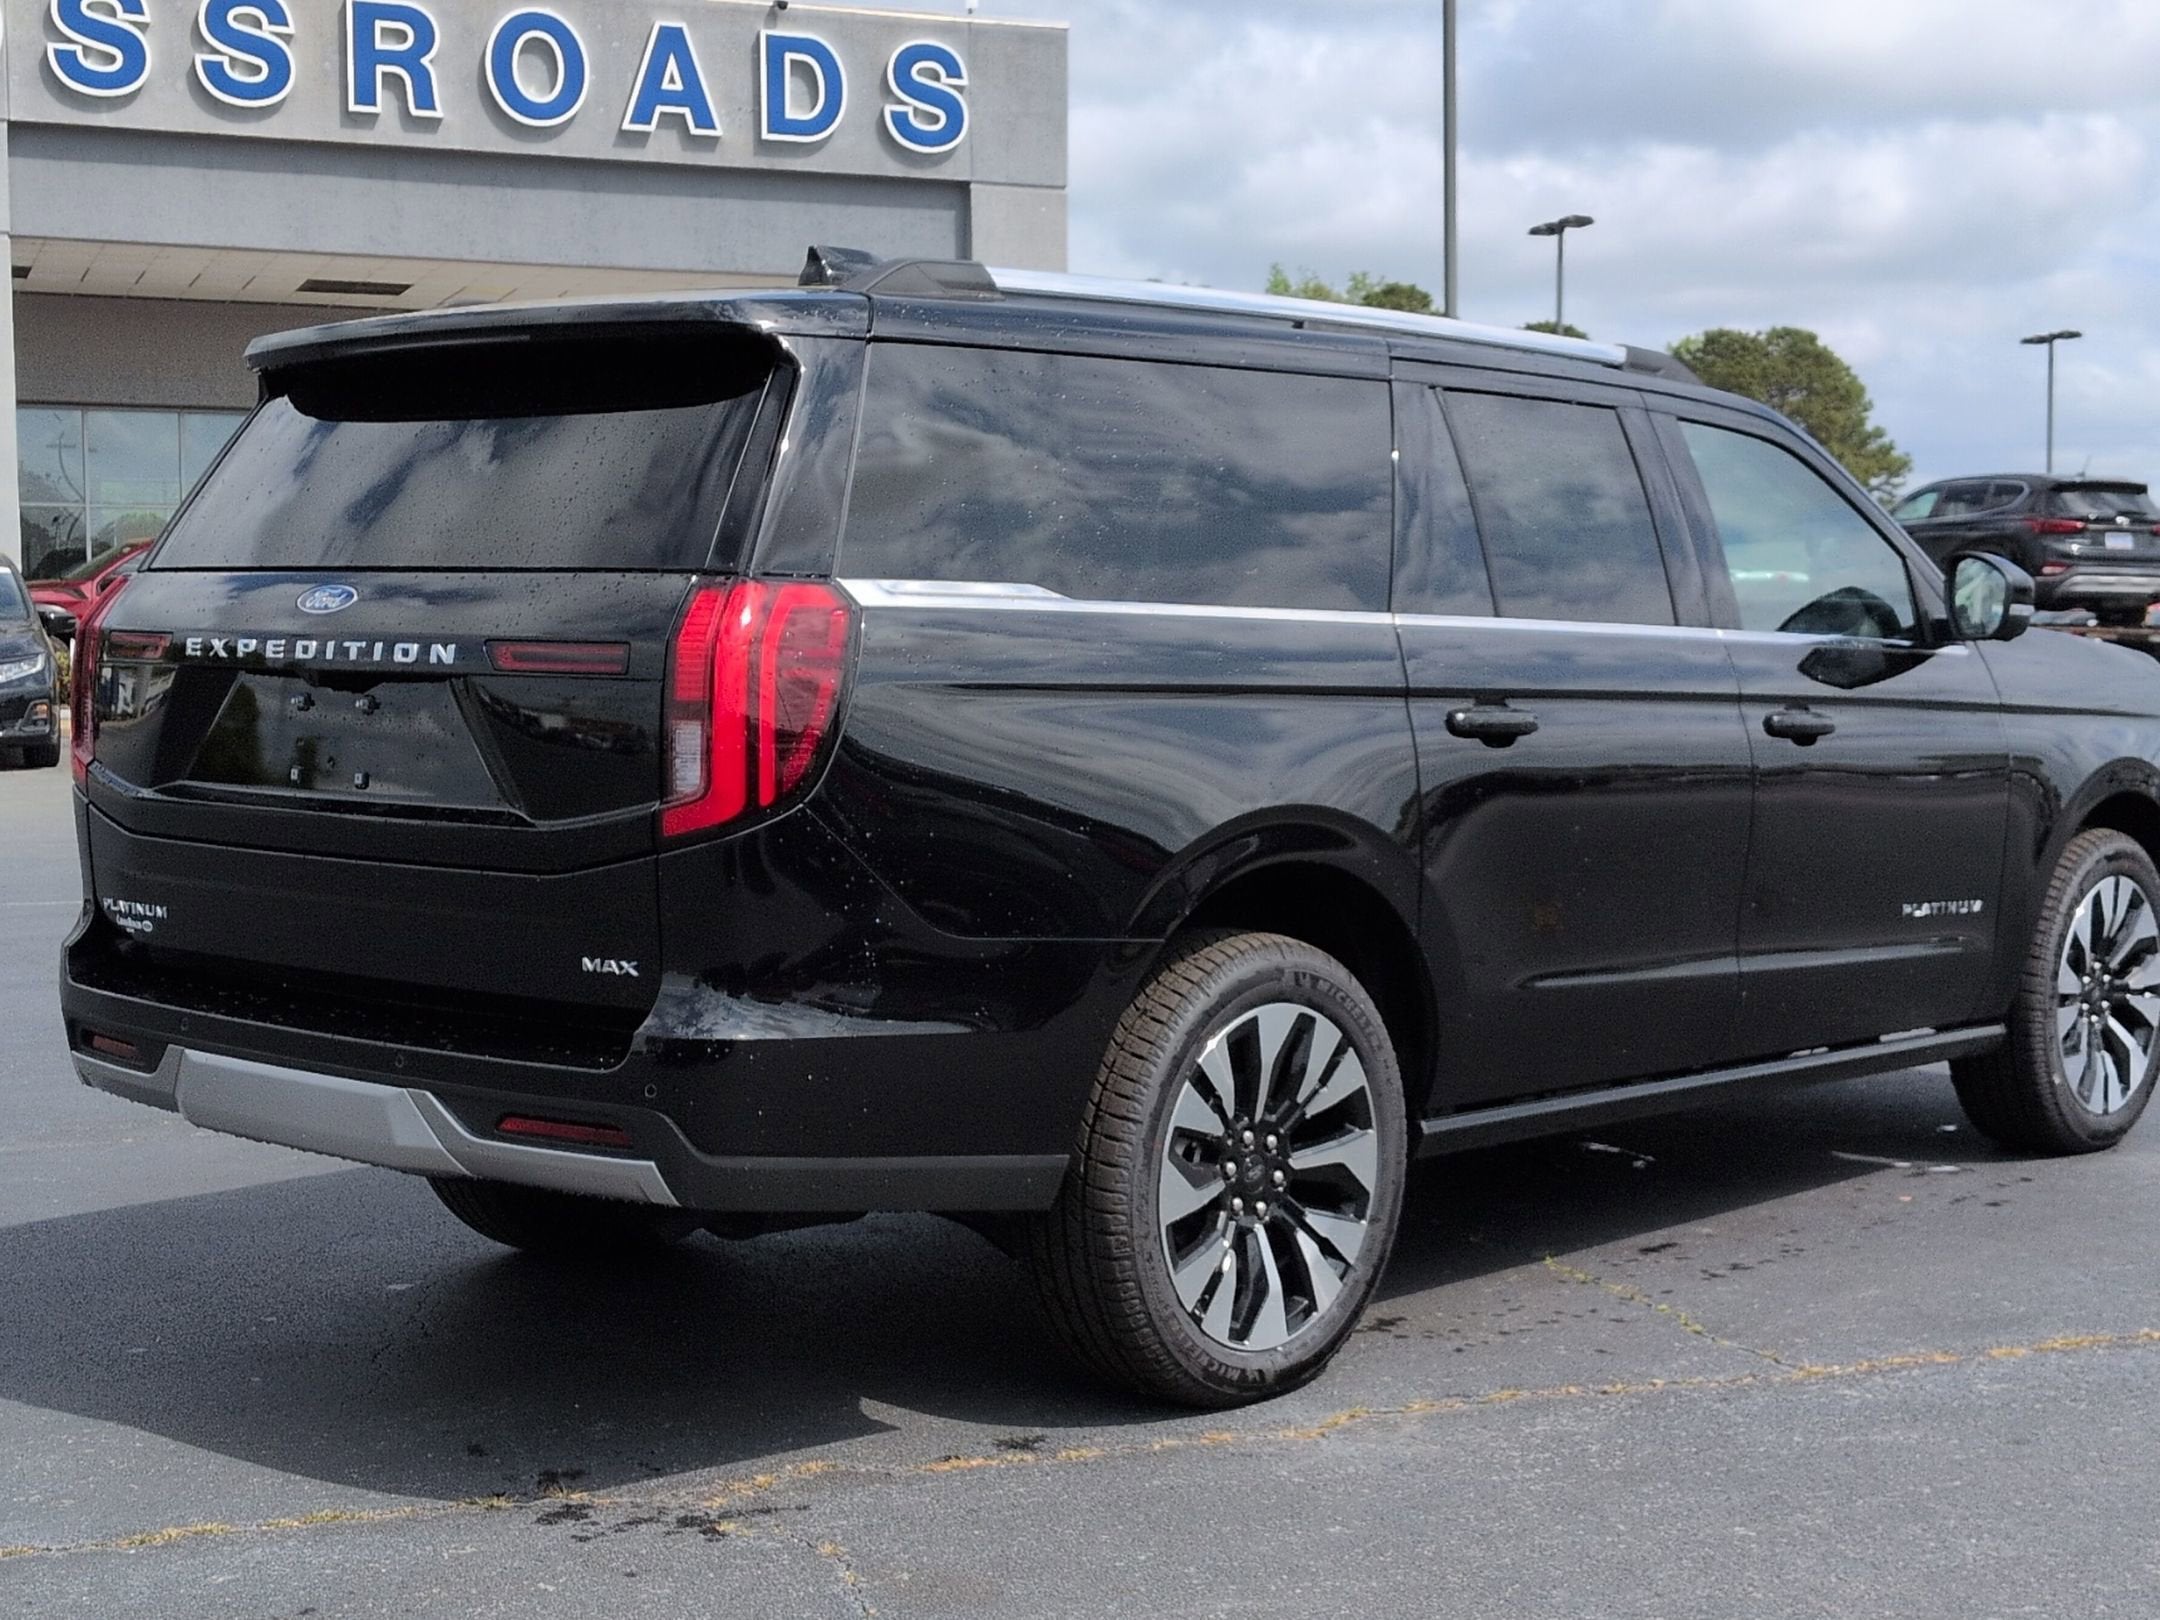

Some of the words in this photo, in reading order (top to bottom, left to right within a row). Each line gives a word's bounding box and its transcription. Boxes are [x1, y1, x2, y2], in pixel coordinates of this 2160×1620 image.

[0, 0, 969, 153] SSROADS
[185, 637, 456, 664] EXPEDITION
[102, 897, 168, 919] PLATINUM
[581, 956, 640, 977] MAX
